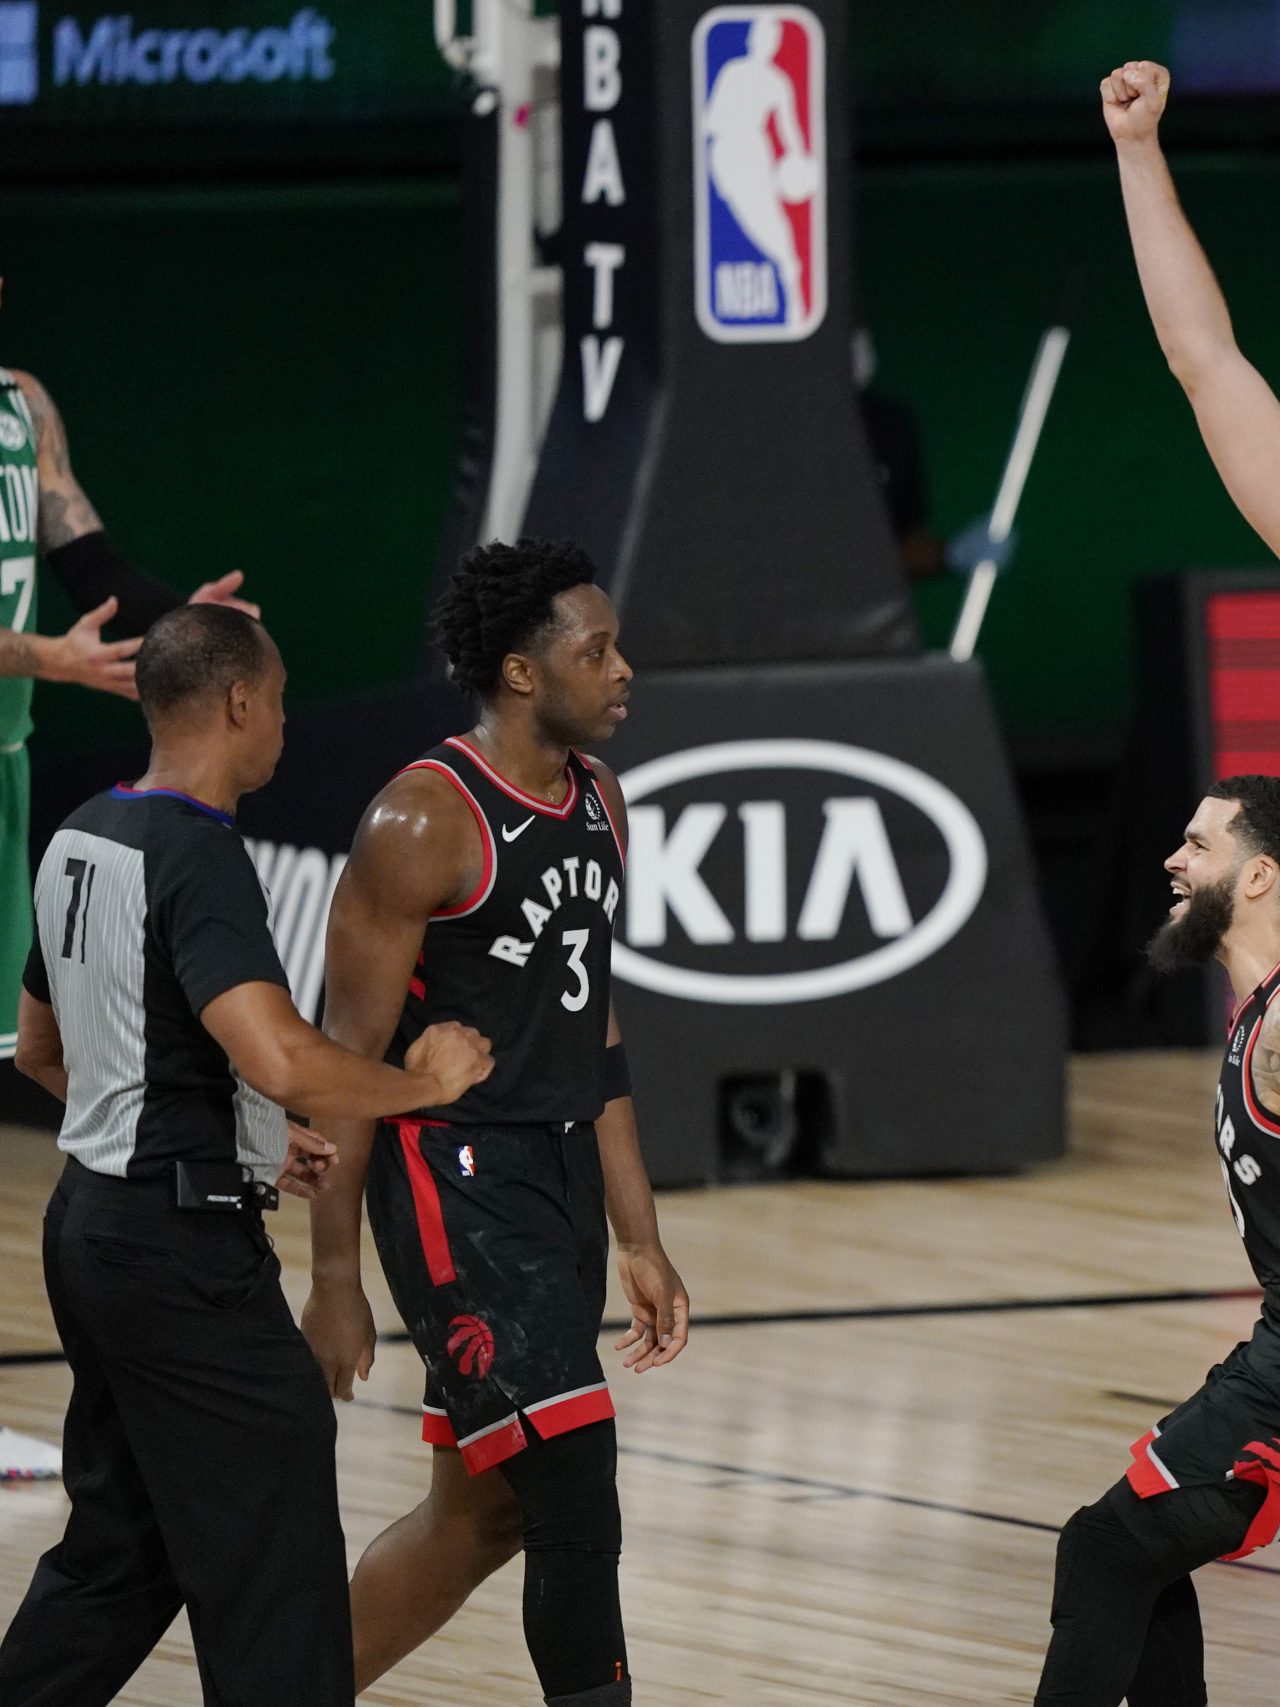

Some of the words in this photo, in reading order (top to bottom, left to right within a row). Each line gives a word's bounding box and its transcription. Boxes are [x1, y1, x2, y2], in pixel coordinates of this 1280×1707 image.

[53, 8, 335, 86] Microsoft
[577, 0, 626, 206] BA
[579, 243, 625, 422] TV
[715, 261, 780, 320] NBA
[626, 796, 914, 947] KIA
[560, 928, 590, 1012] 3
